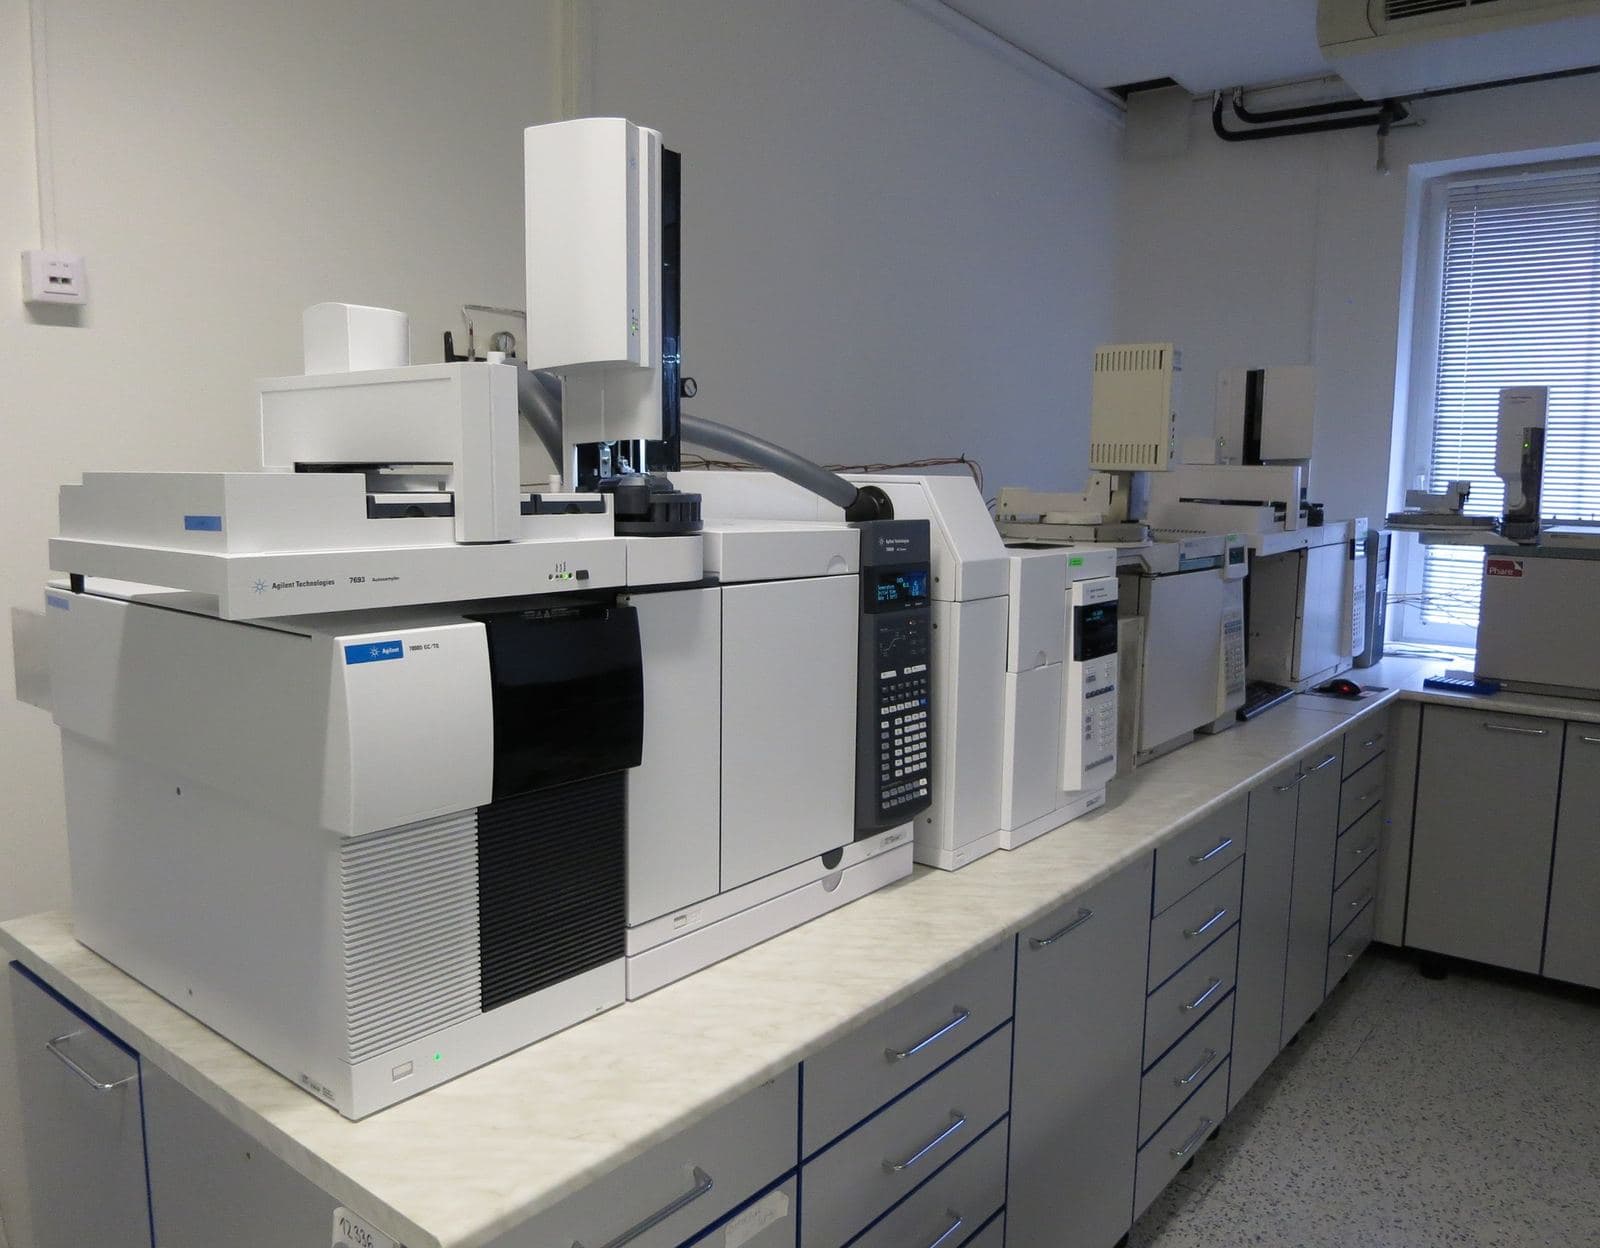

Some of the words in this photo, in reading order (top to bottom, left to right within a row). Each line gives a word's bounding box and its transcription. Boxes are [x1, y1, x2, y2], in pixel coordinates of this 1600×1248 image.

[271, 581, 295, 590] Agilent
[296, 579, 335, 589] Technologies
[349, 576, 366, 584] 7693
